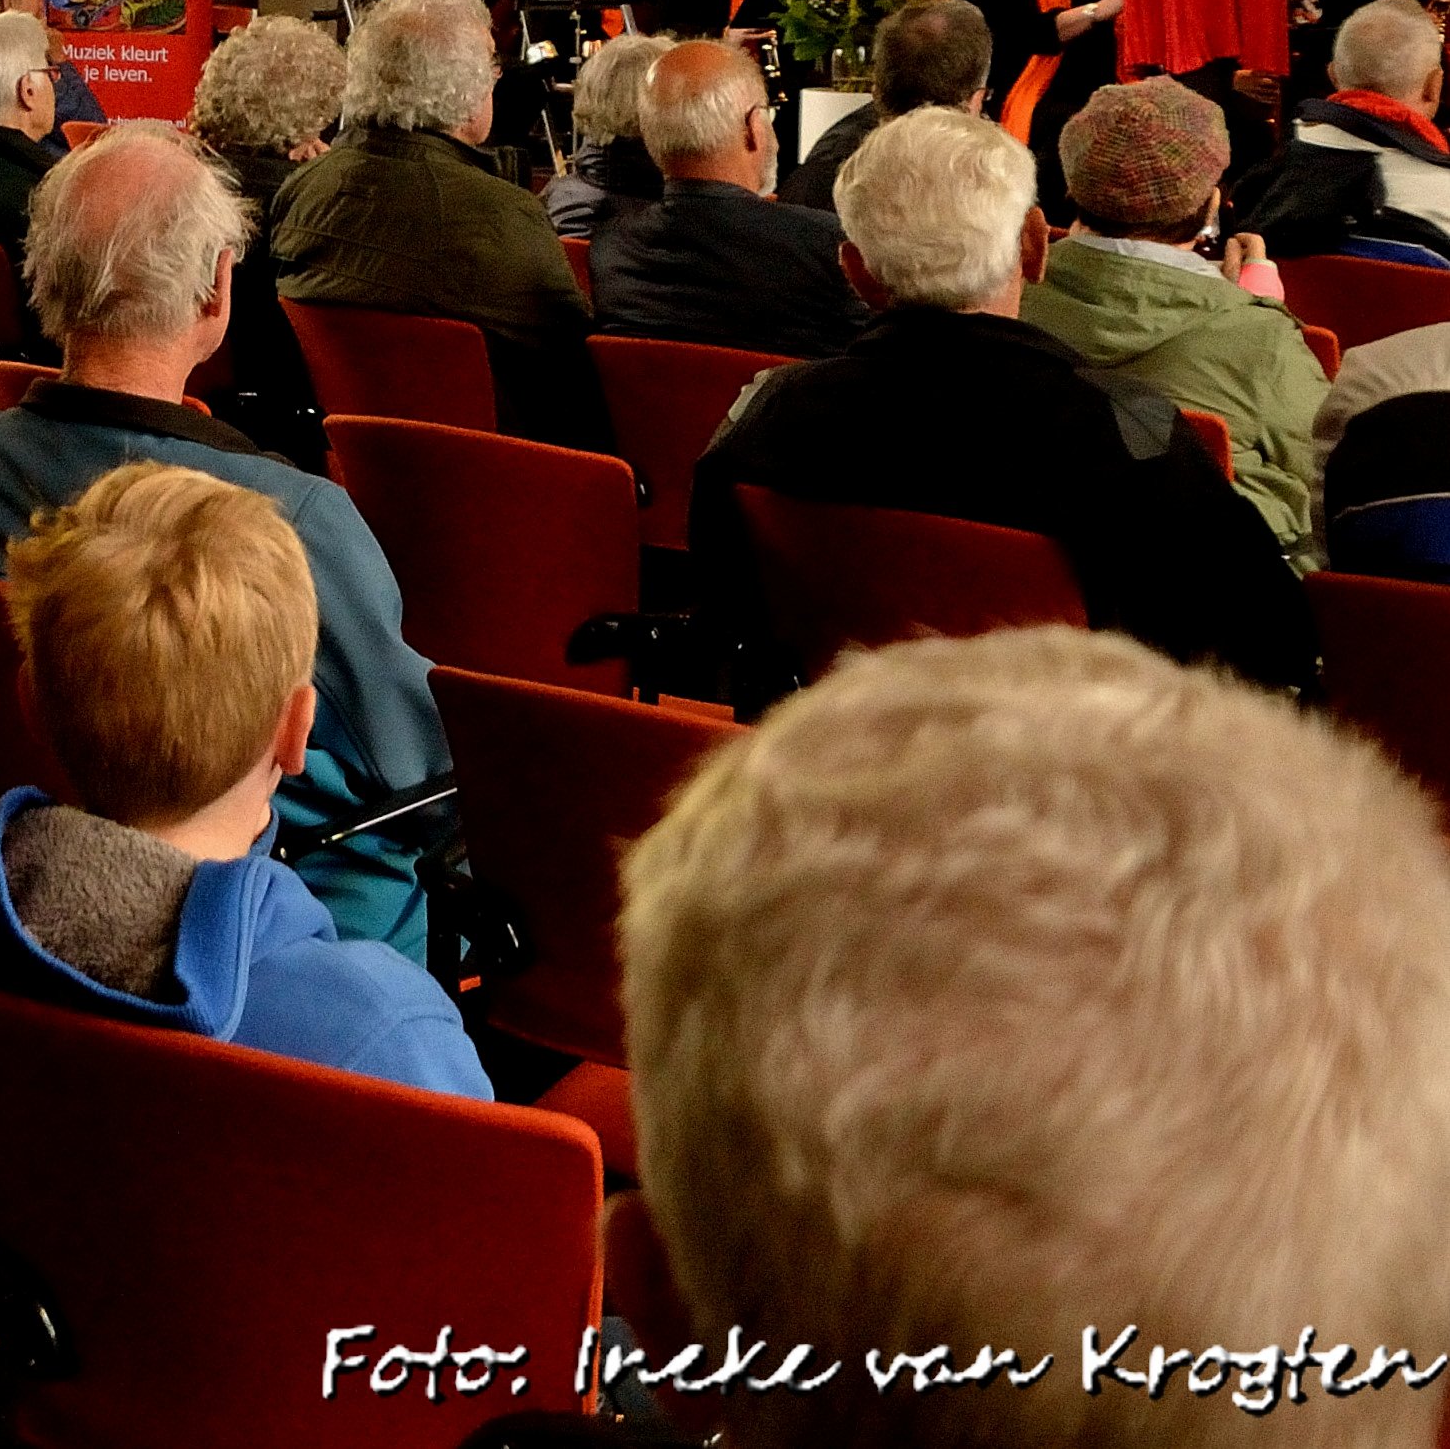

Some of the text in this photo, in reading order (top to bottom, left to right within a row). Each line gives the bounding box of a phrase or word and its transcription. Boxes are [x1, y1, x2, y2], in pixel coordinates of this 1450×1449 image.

[62, 44, 169, 63] Muziek kleurt
[84, 64, 153, 83] je leven.
